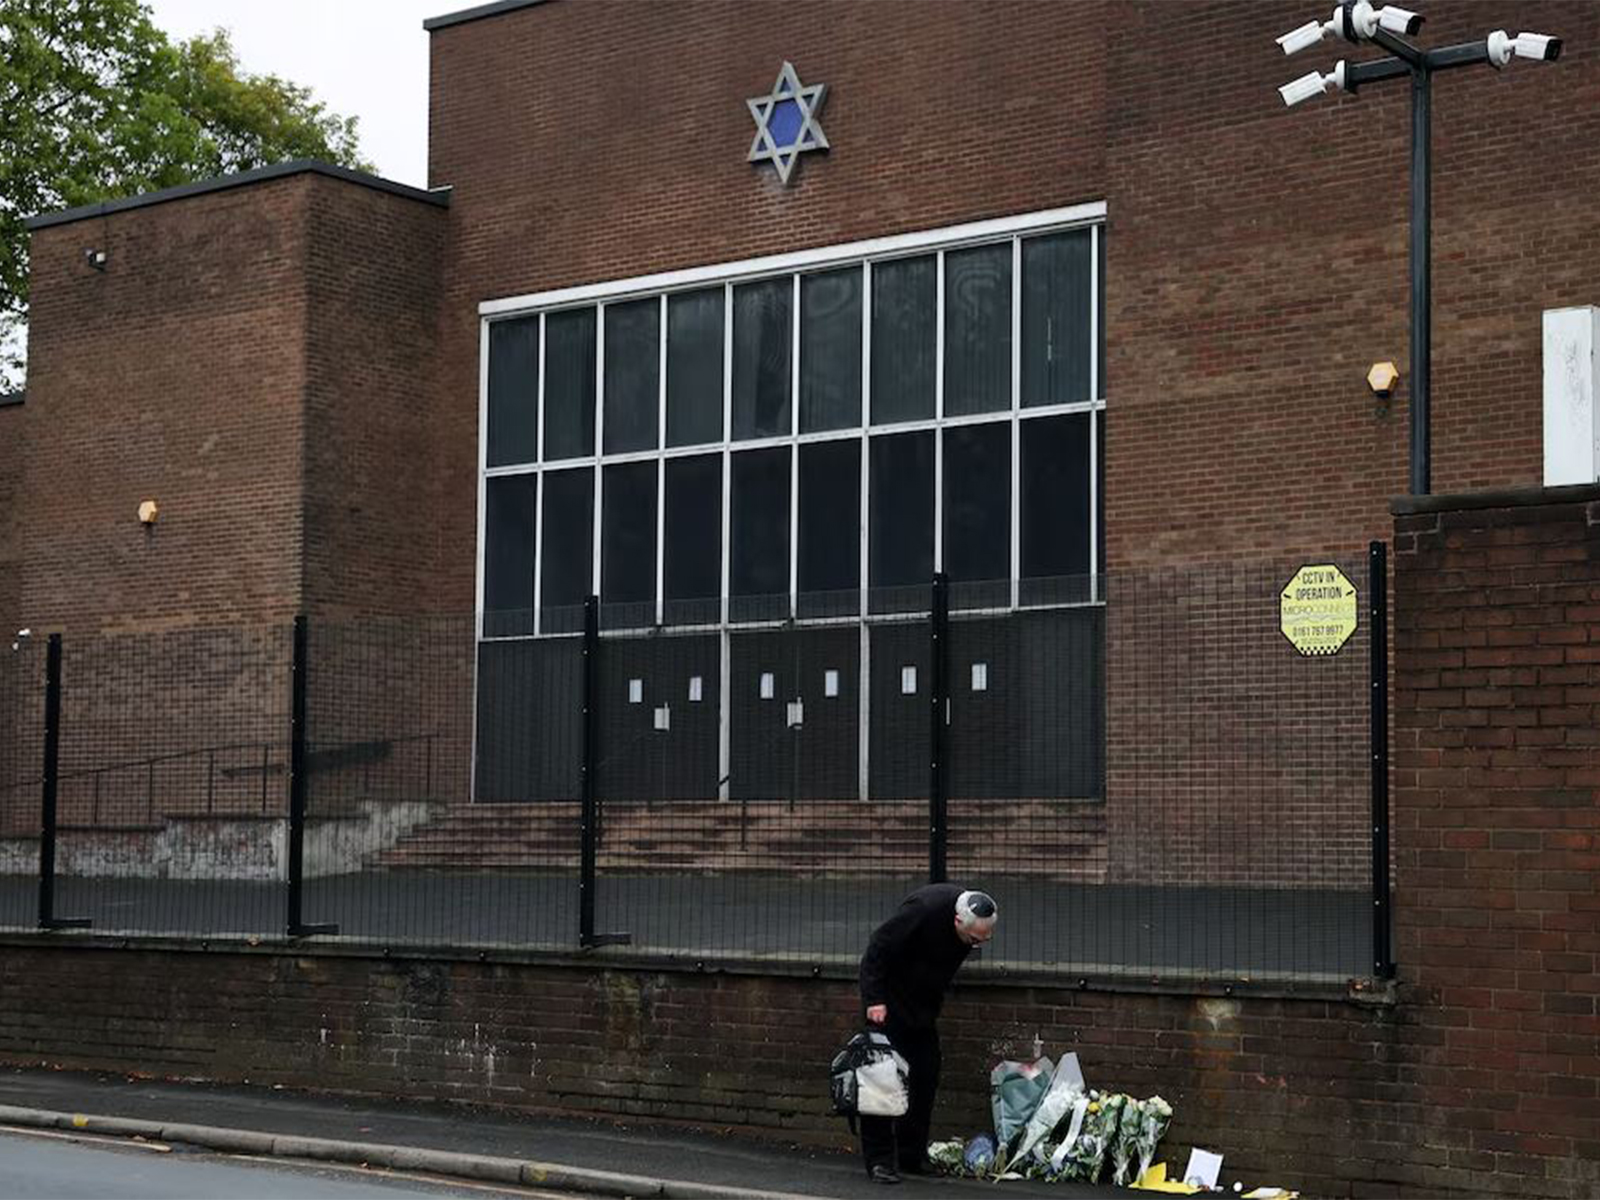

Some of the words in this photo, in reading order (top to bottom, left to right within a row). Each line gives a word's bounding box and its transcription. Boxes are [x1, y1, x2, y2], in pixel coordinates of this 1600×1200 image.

[1303, 571, 1324, 584] CCTV
[1326, 571, 1335, 583] IN
[1296, 586, 1342, 601] OPERATION
